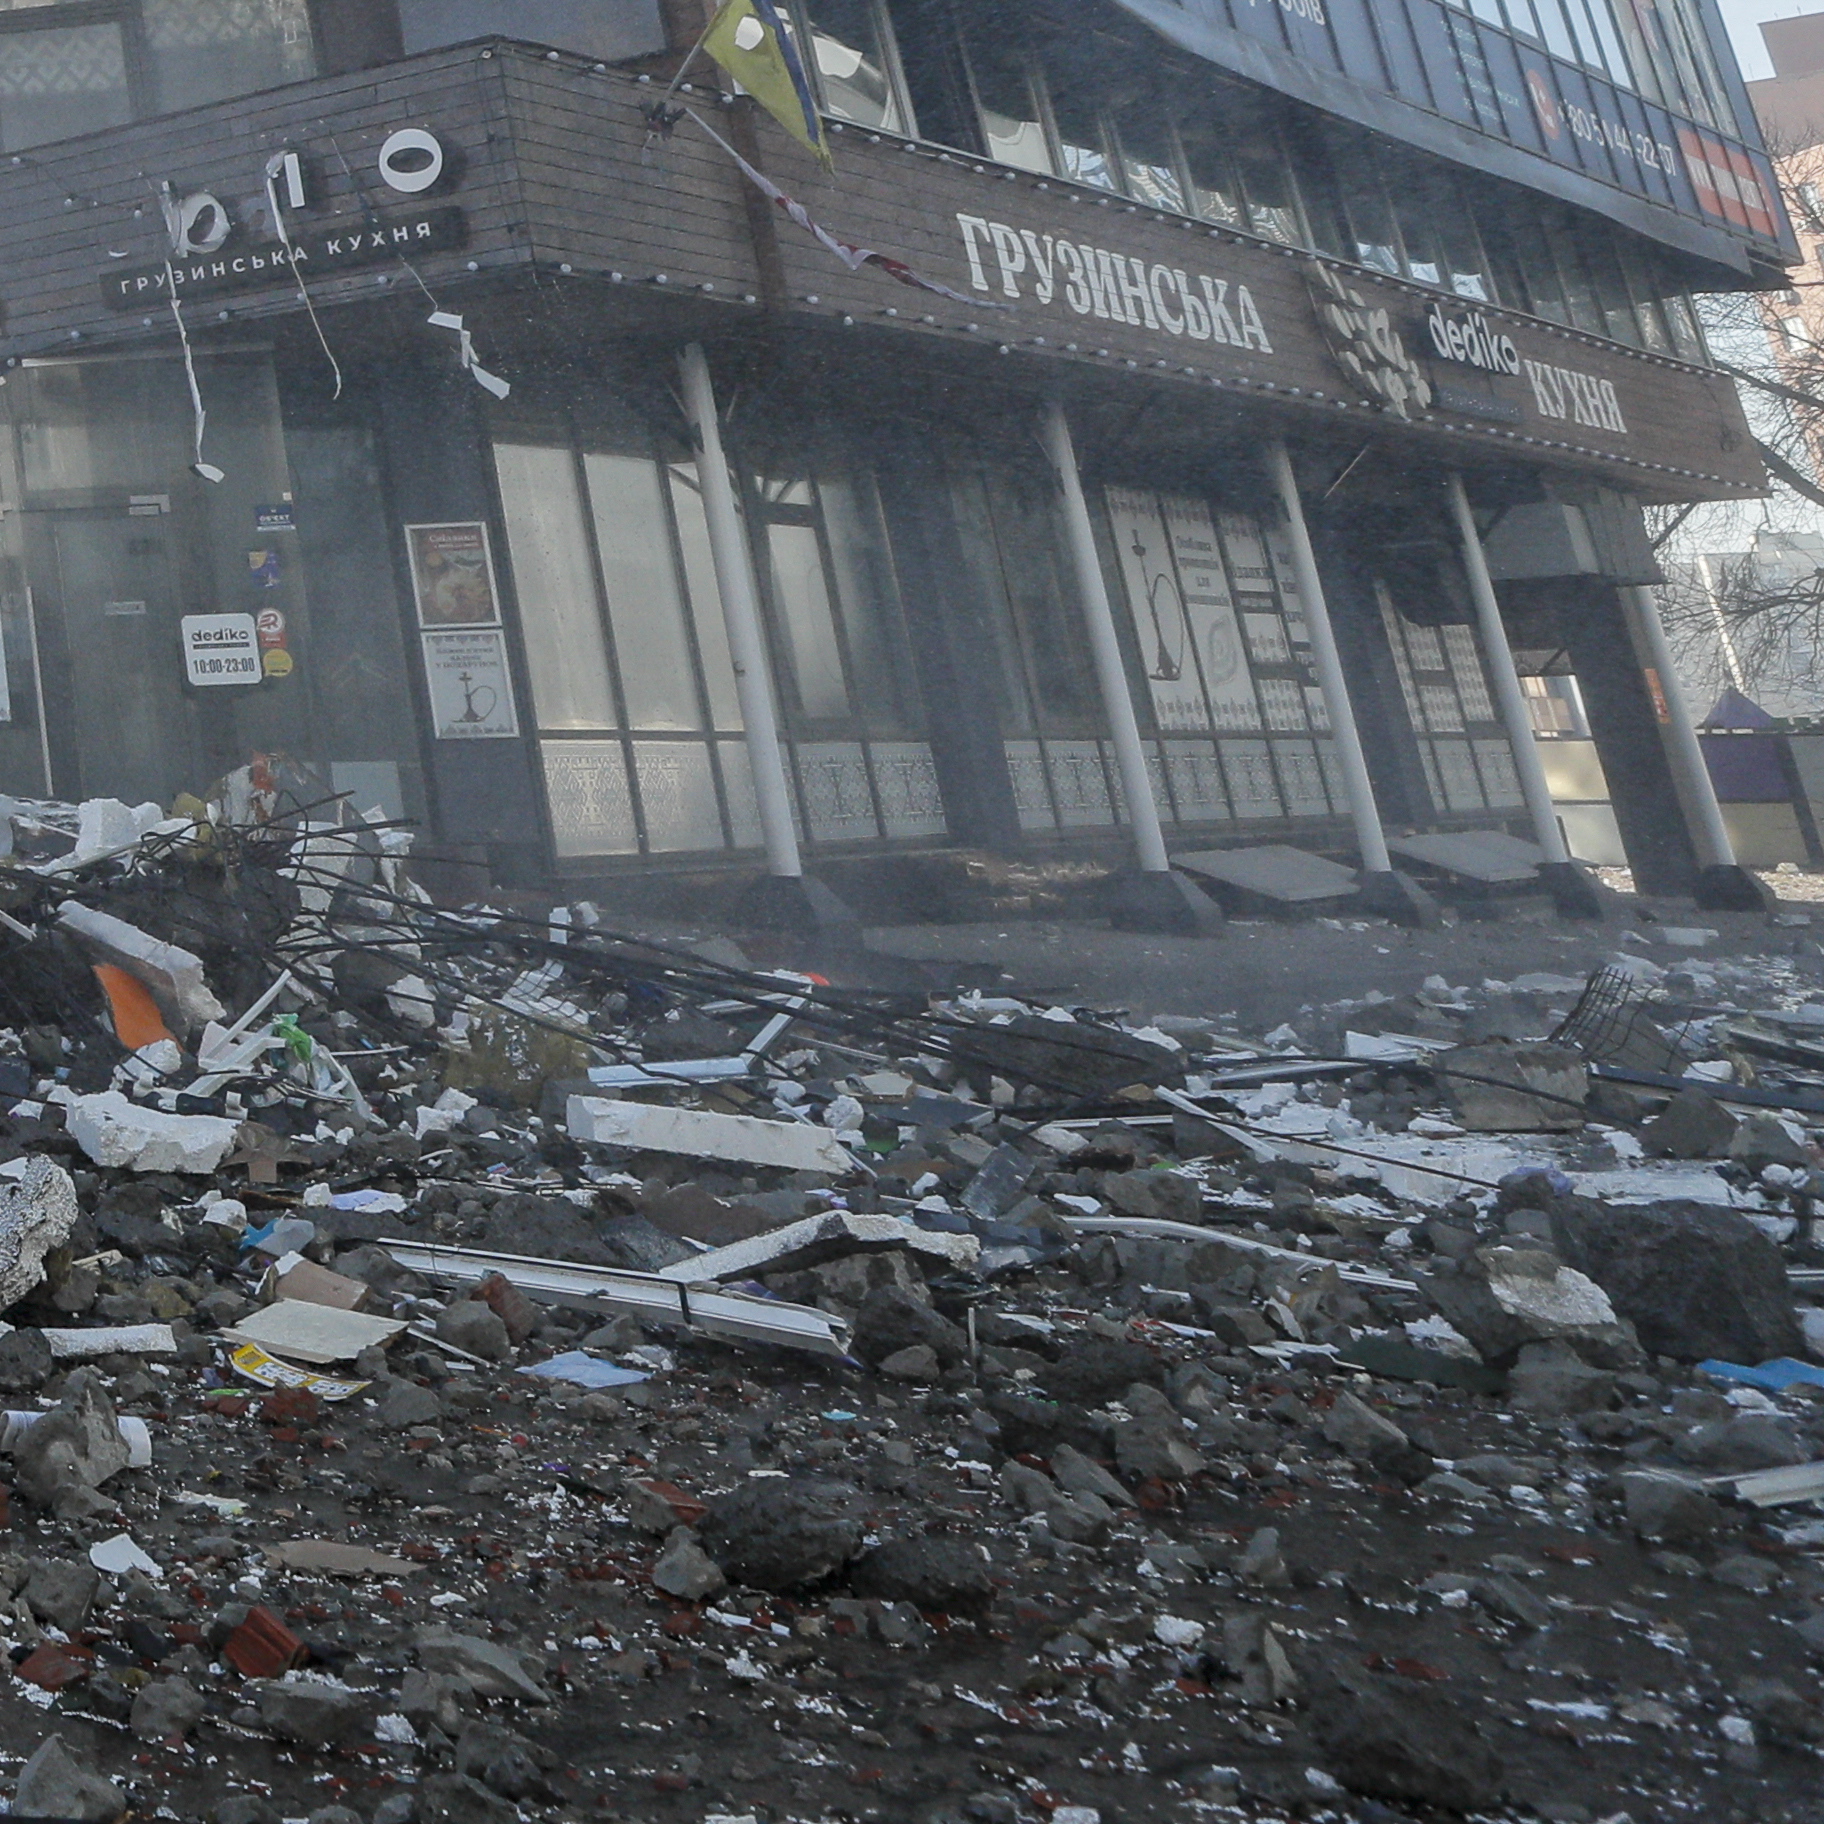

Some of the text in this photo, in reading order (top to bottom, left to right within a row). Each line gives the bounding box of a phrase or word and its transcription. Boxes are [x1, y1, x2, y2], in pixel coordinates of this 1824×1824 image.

[120, 222, 432, 295] ГРУЗИНСЬКА КУХНЯ
[955, 212, 1274, 355] ГРУЗИНСЬКА
[1426, 302, 1521, 377] dediko
[1524, 358, 1629, 434] КУХНЯ
[191, 627, 250, 642] dediko
[193, 656, 256, 675] 10:00-23:00
